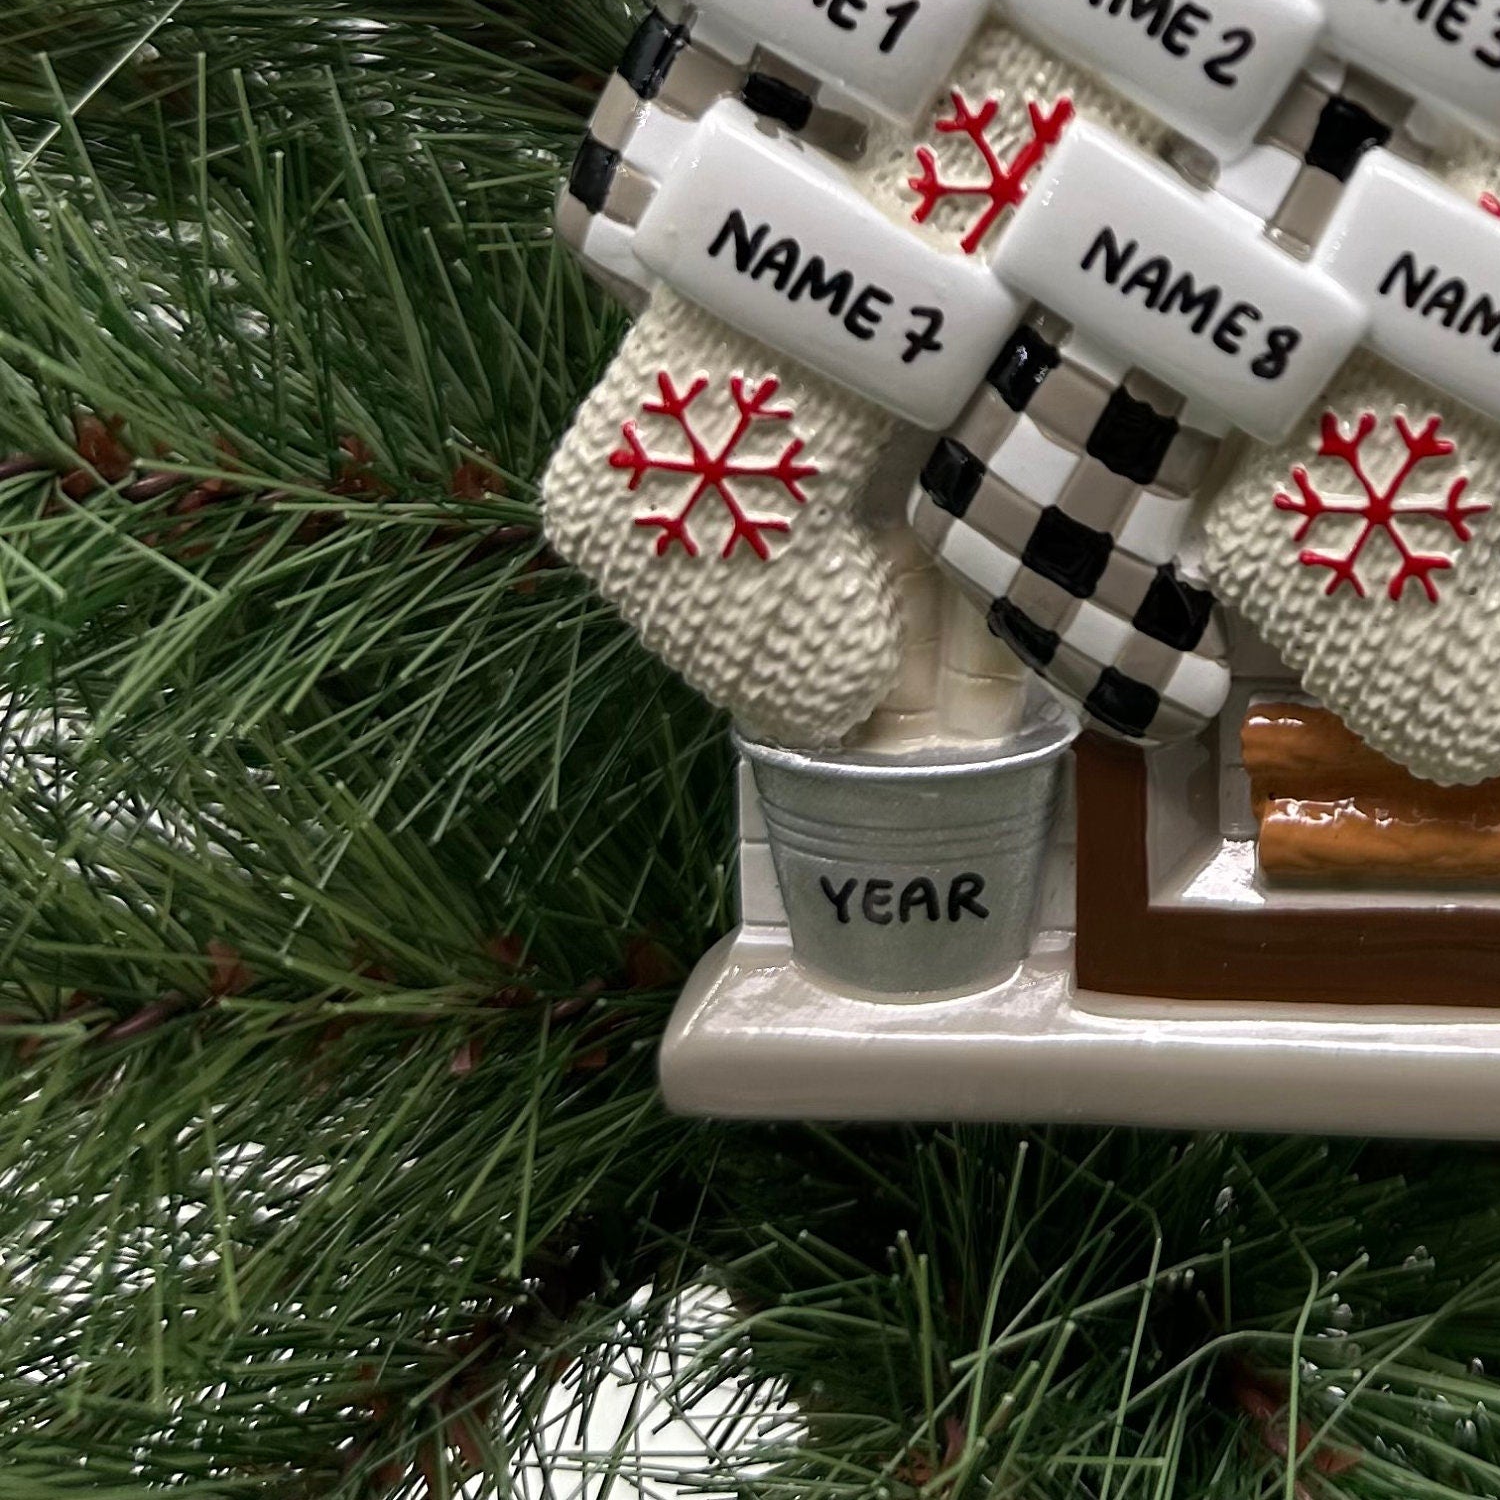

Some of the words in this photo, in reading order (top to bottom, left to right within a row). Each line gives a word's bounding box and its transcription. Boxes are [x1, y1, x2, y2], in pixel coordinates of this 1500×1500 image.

[1201, 27, 1255, 89] 2
[706, 209, 895, 342] NAME
[899, 305, 945, 365] 7
[1079, 226, 1263, 356] NAME
[1249, 326, 1302, 382] 8
[817, 870, 990, 926] YEAR
